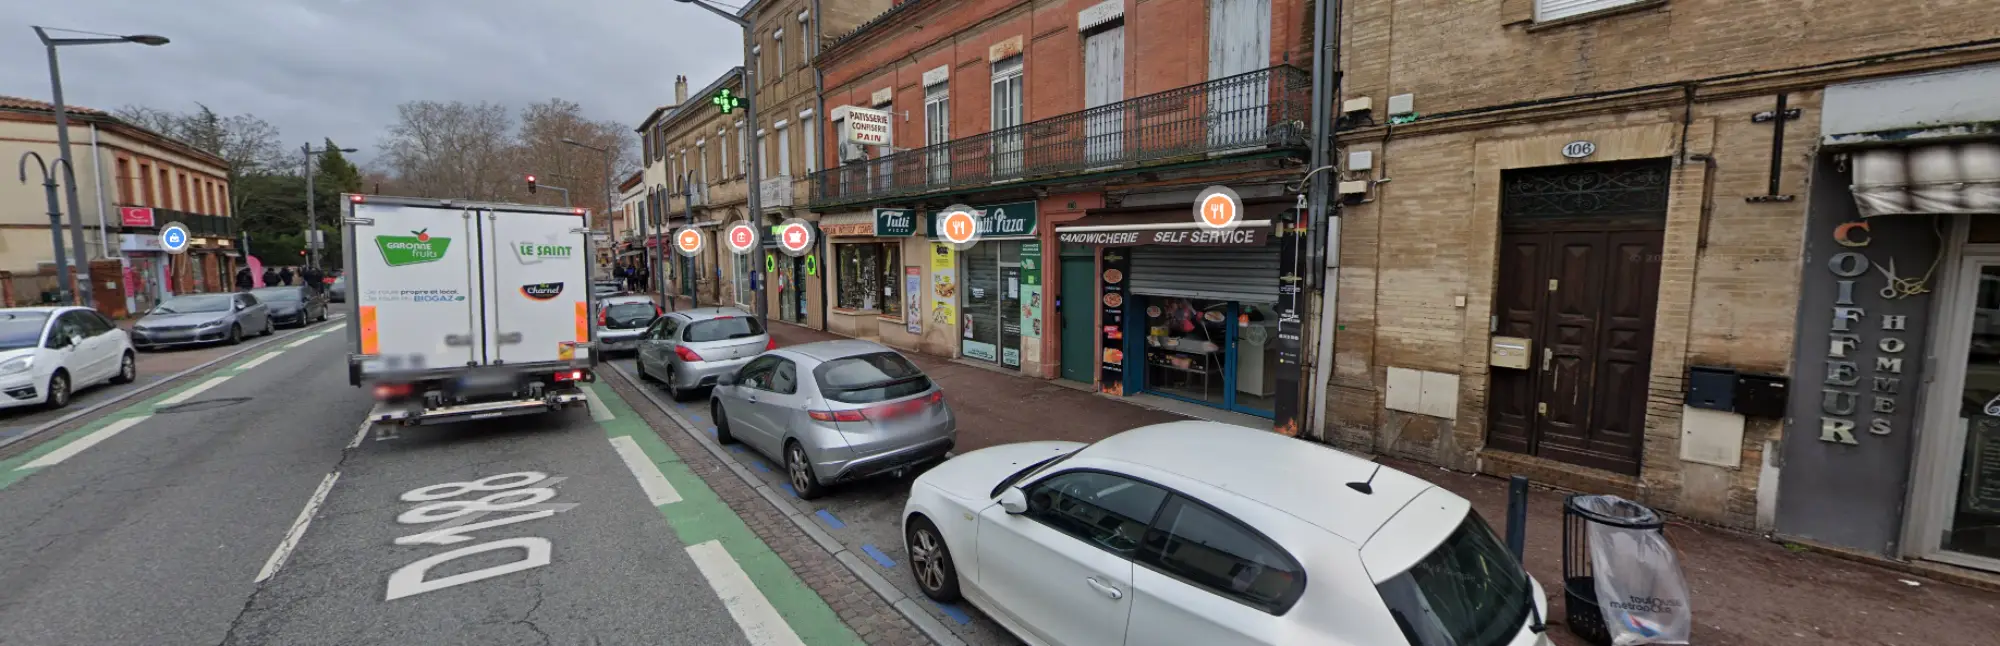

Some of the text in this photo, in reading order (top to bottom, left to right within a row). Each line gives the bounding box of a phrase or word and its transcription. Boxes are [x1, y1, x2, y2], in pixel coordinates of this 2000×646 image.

[850, 111, 888, 124] PATISSERIE
[857, 133, 881, 142] PAIN
[1567, 143, 1592, 155] 106
[880, 211, 910, 227] Tutti
[994, 208, 1025, 232] Pizza
[1060, 230, 1255, 244] SANDWICHERIE SELF SERVICE
[387, 242, 432, 250] GARONNE
[520, 245, 572, 256] LE SAINT
[412, 248, 437, 258] fruits
[1819, 221, 1872, 445] COIFFEUR
[1869, 314, 1908, 436] HOMMES
[386, 471, 555, 601] D188
